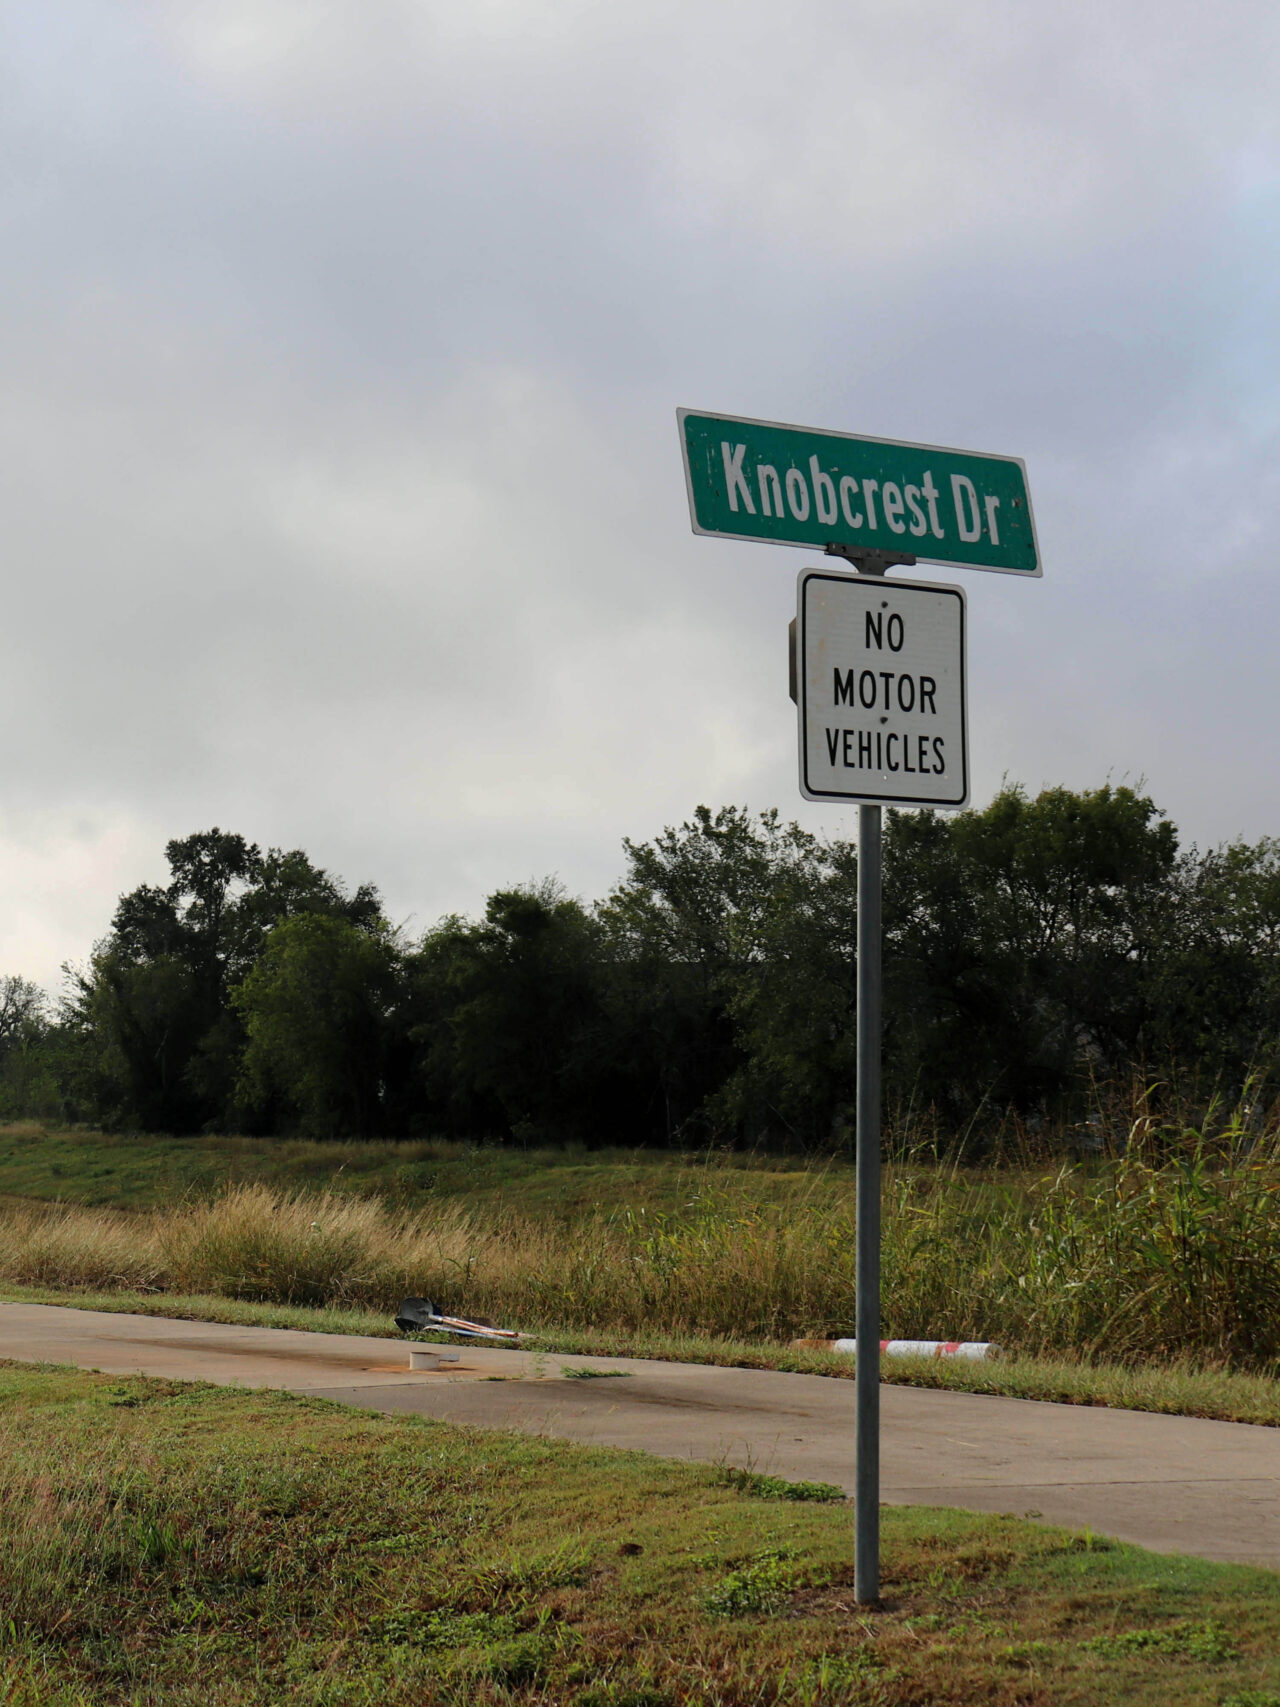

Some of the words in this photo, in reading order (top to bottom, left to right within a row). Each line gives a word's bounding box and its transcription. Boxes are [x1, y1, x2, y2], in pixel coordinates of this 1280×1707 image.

[721, 441, 944, 539] Knobcrest
[950, 473, 1000, 545] Dr
[865, 611, 904, 652] NO
[833, 667, 937, 714] MOTOR
[825, 727, 945, 775] VEHICLES
